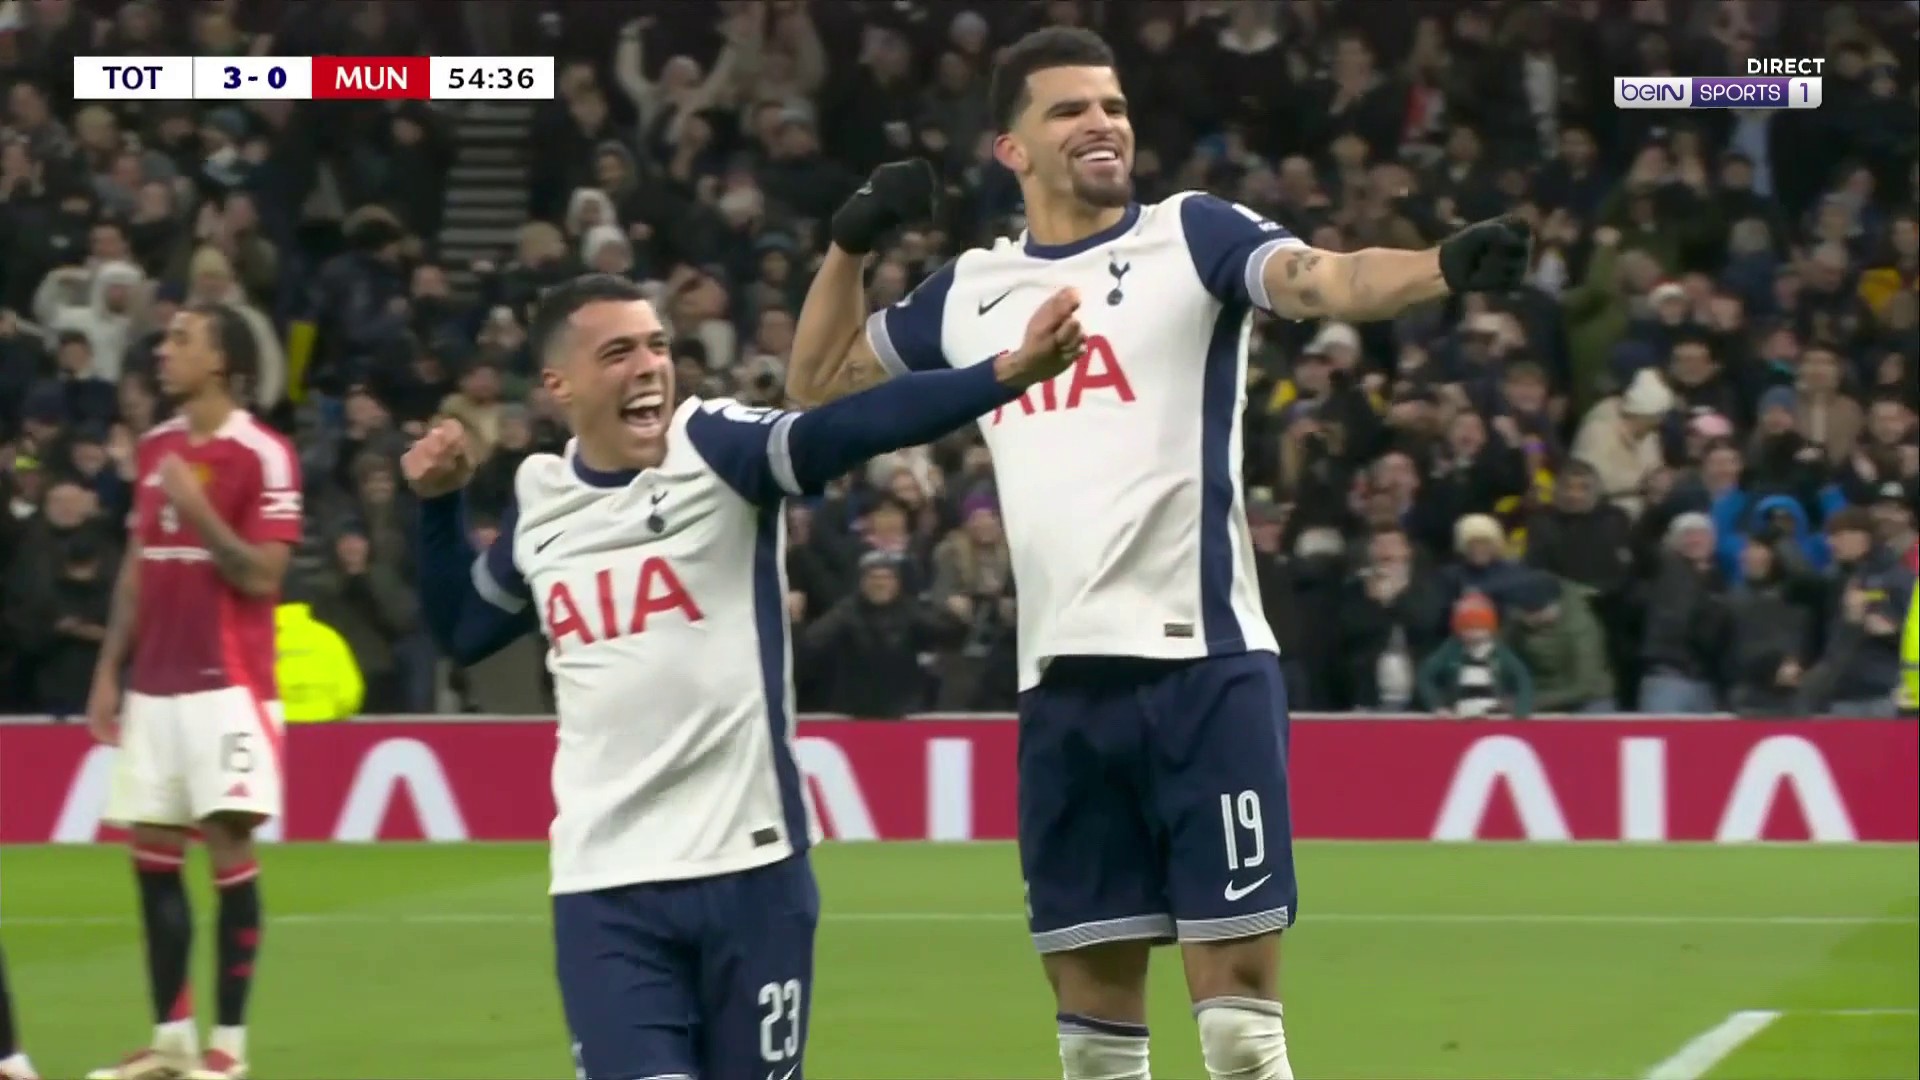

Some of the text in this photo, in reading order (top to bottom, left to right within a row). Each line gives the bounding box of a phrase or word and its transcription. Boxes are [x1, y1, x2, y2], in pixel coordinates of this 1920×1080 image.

[546, 555, 706, 650] AIA
[1220, 789, 1265, 870] 19
[1430, 734, 1859, 842] AIA
[758, 978, 802, 1062] 23
